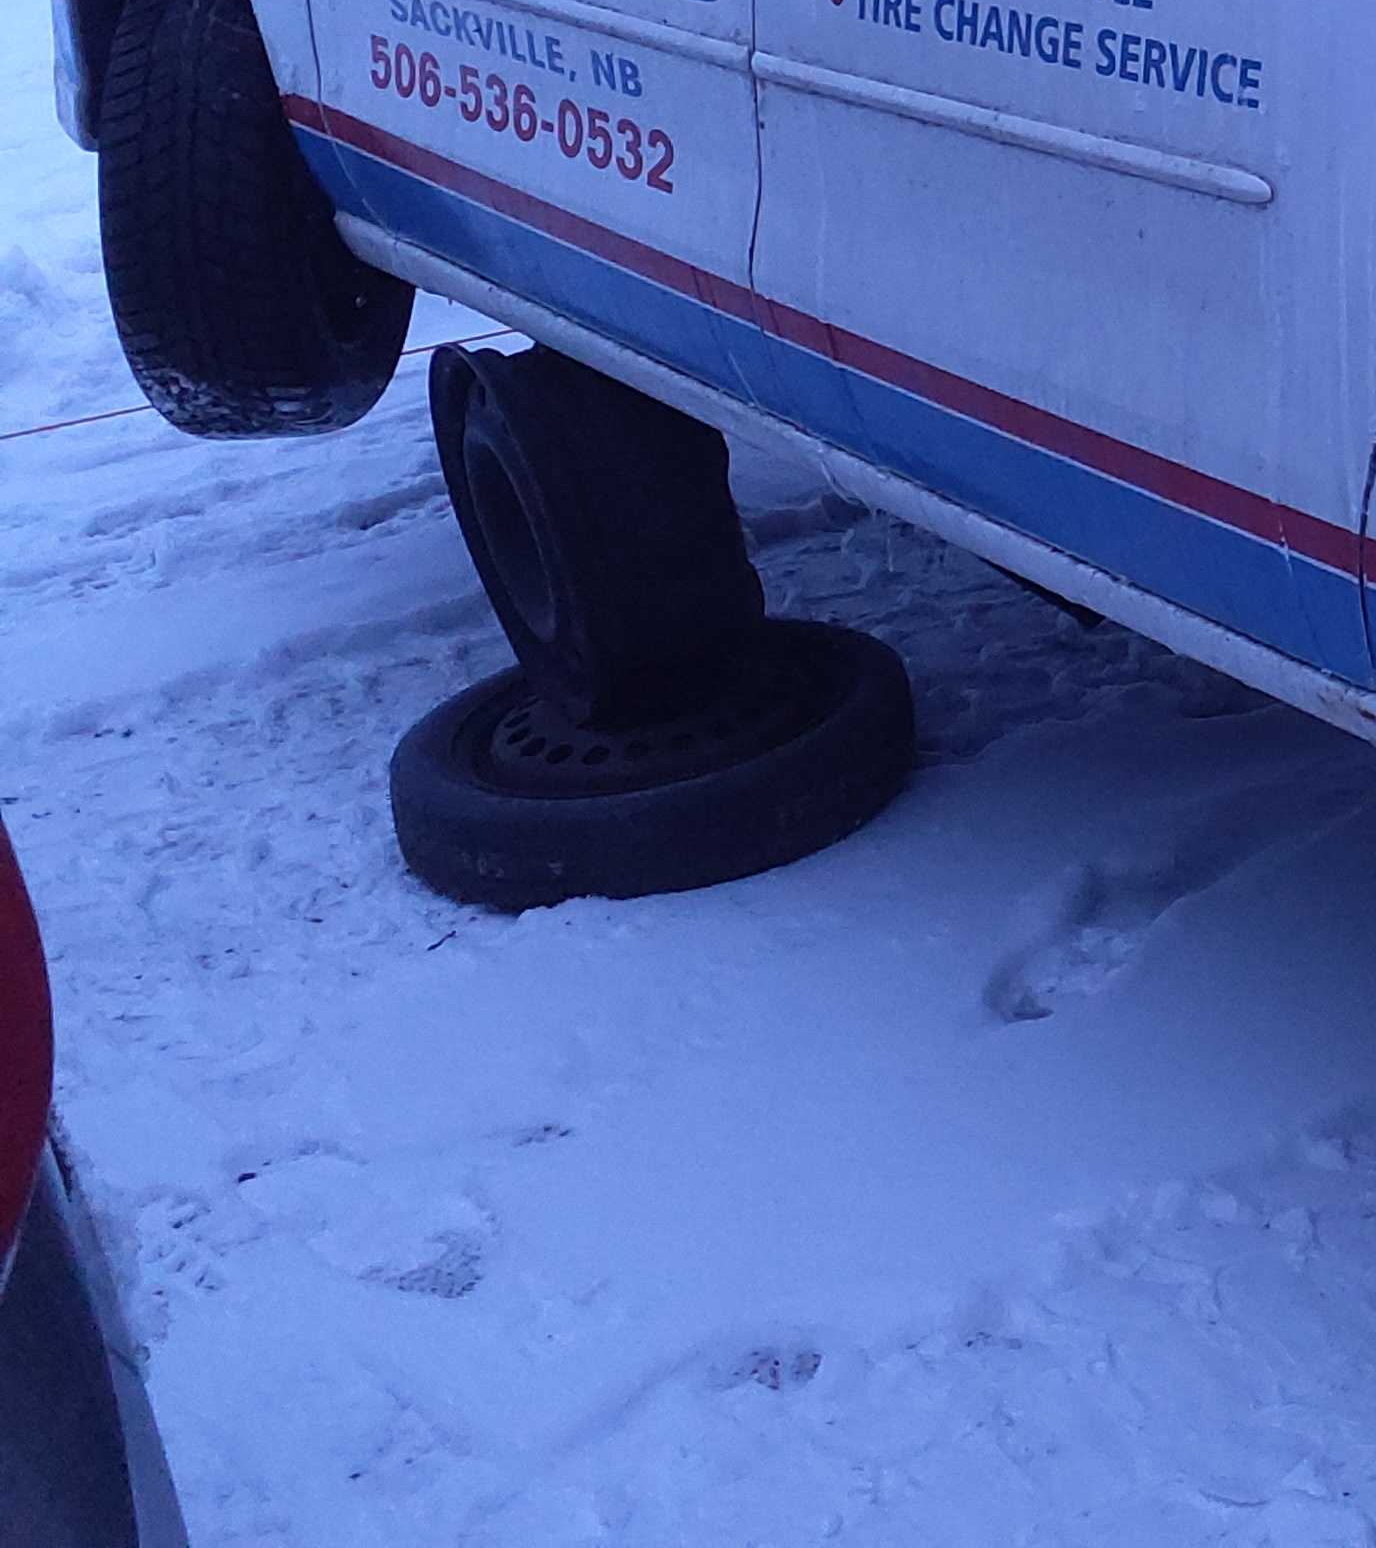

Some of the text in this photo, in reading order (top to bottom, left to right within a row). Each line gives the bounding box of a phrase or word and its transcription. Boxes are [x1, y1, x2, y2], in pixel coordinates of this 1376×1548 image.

[592, 52, 643, 97] NB
[1096, 29, 1262, 108] SERVICE
[370, 34, 675, 194] 506-536-0532
